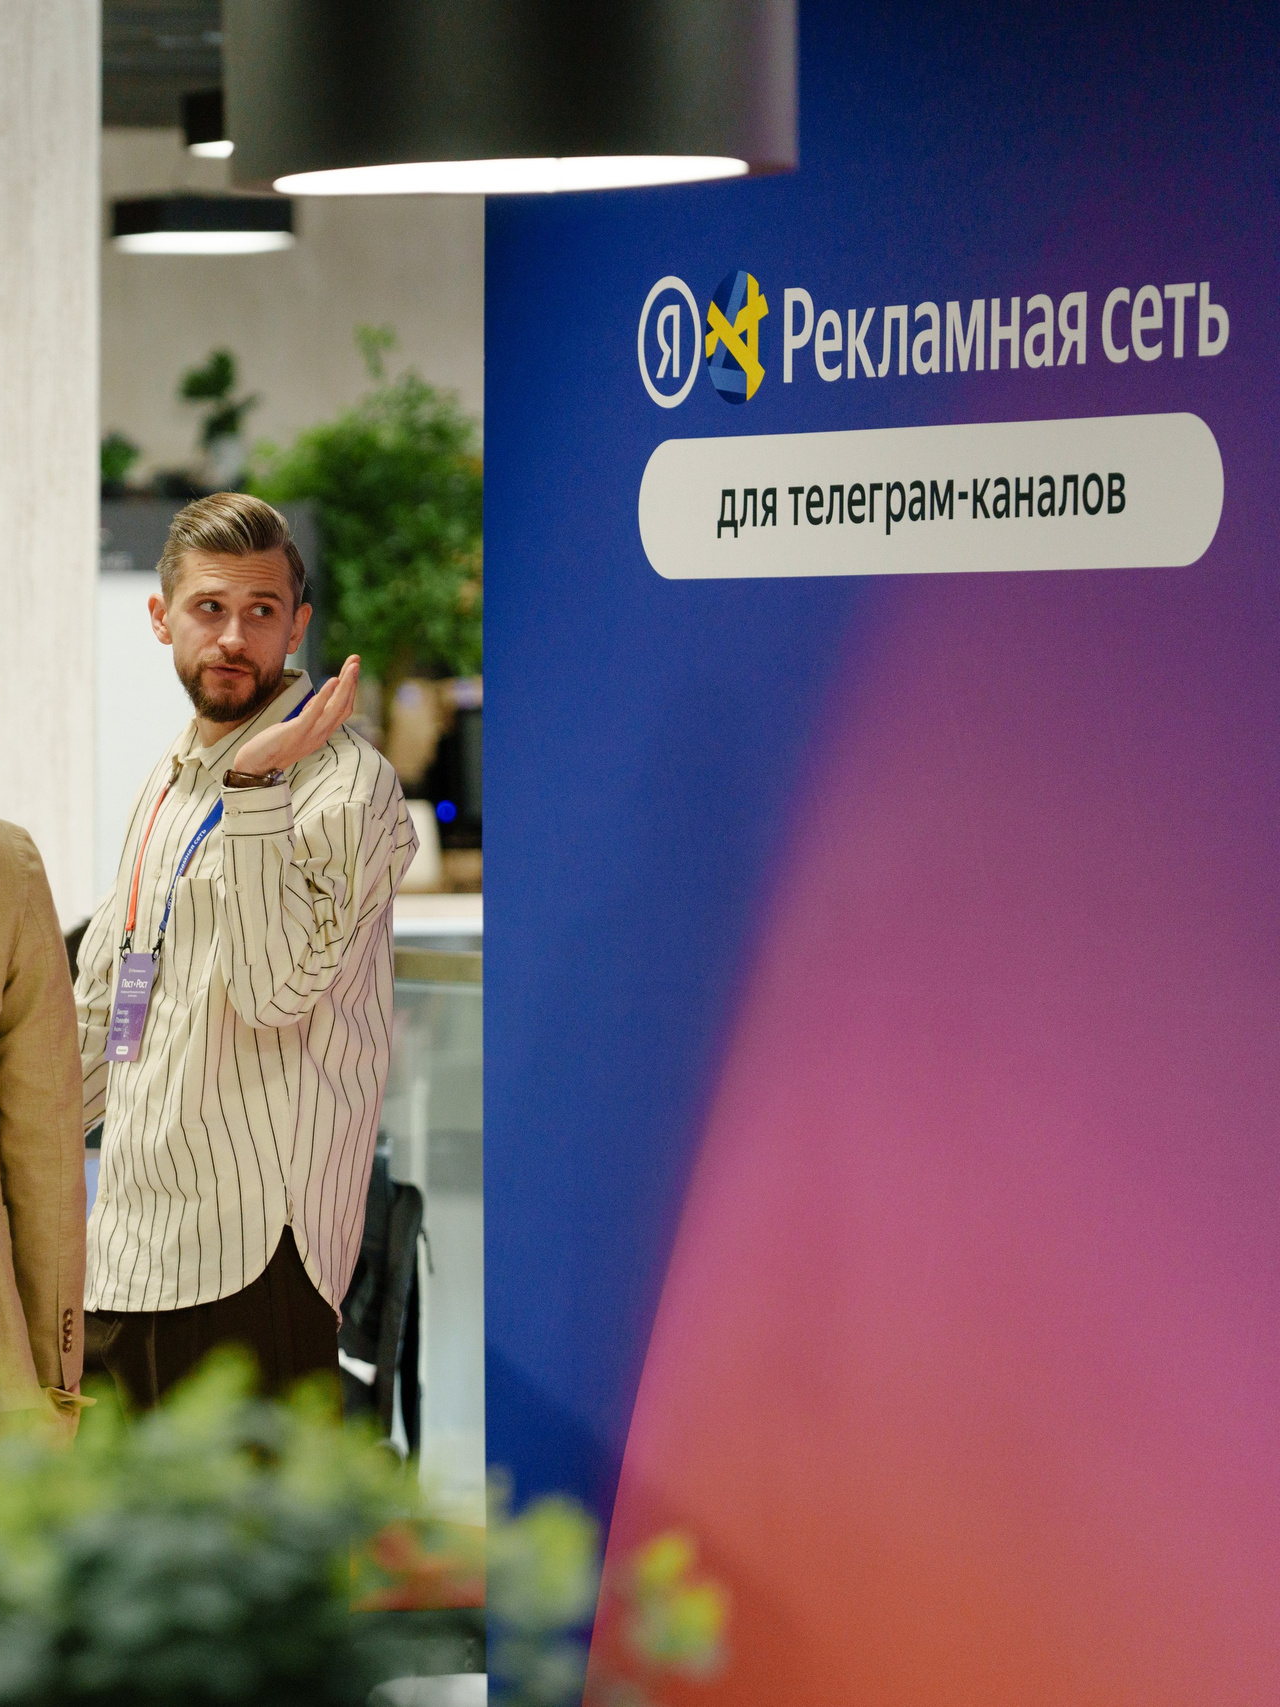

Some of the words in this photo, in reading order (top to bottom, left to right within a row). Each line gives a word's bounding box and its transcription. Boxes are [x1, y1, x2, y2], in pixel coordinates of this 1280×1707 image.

[783, 287, 1087, 384] Рекламная
[1102, 281, 1230, 363] сеть
[717, 486, 777, 539] для
[788, 471, 1126, 536] телеграм-каналов
